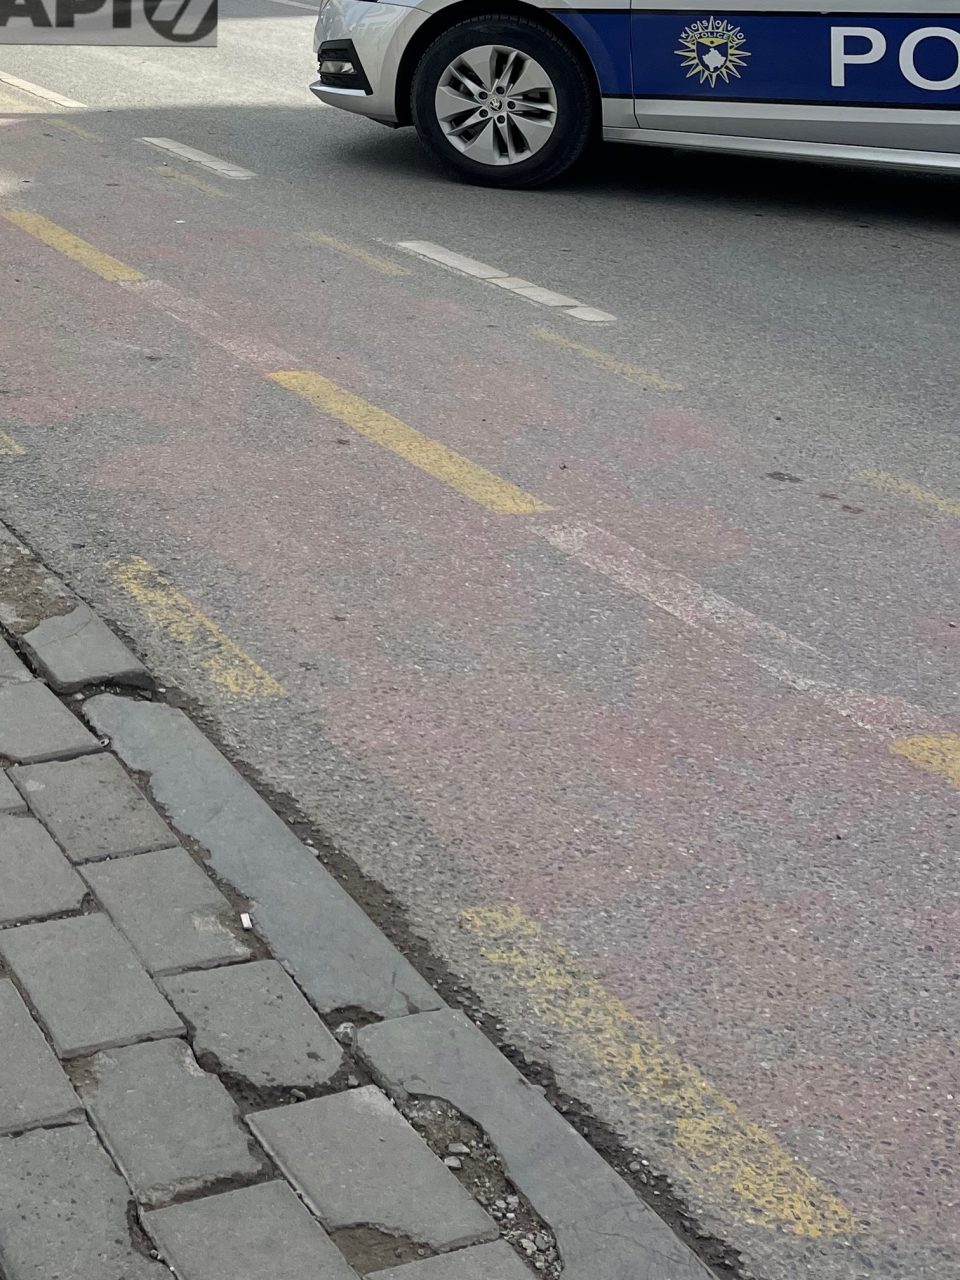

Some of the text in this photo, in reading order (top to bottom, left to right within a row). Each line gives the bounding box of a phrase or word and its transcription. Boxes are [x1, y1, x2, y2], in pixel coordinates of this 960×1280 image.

[680, 19, 745, 40] KOSOVO
[695, 32, 730, 40] POLICE
[830, 26, 960, 91] PO
